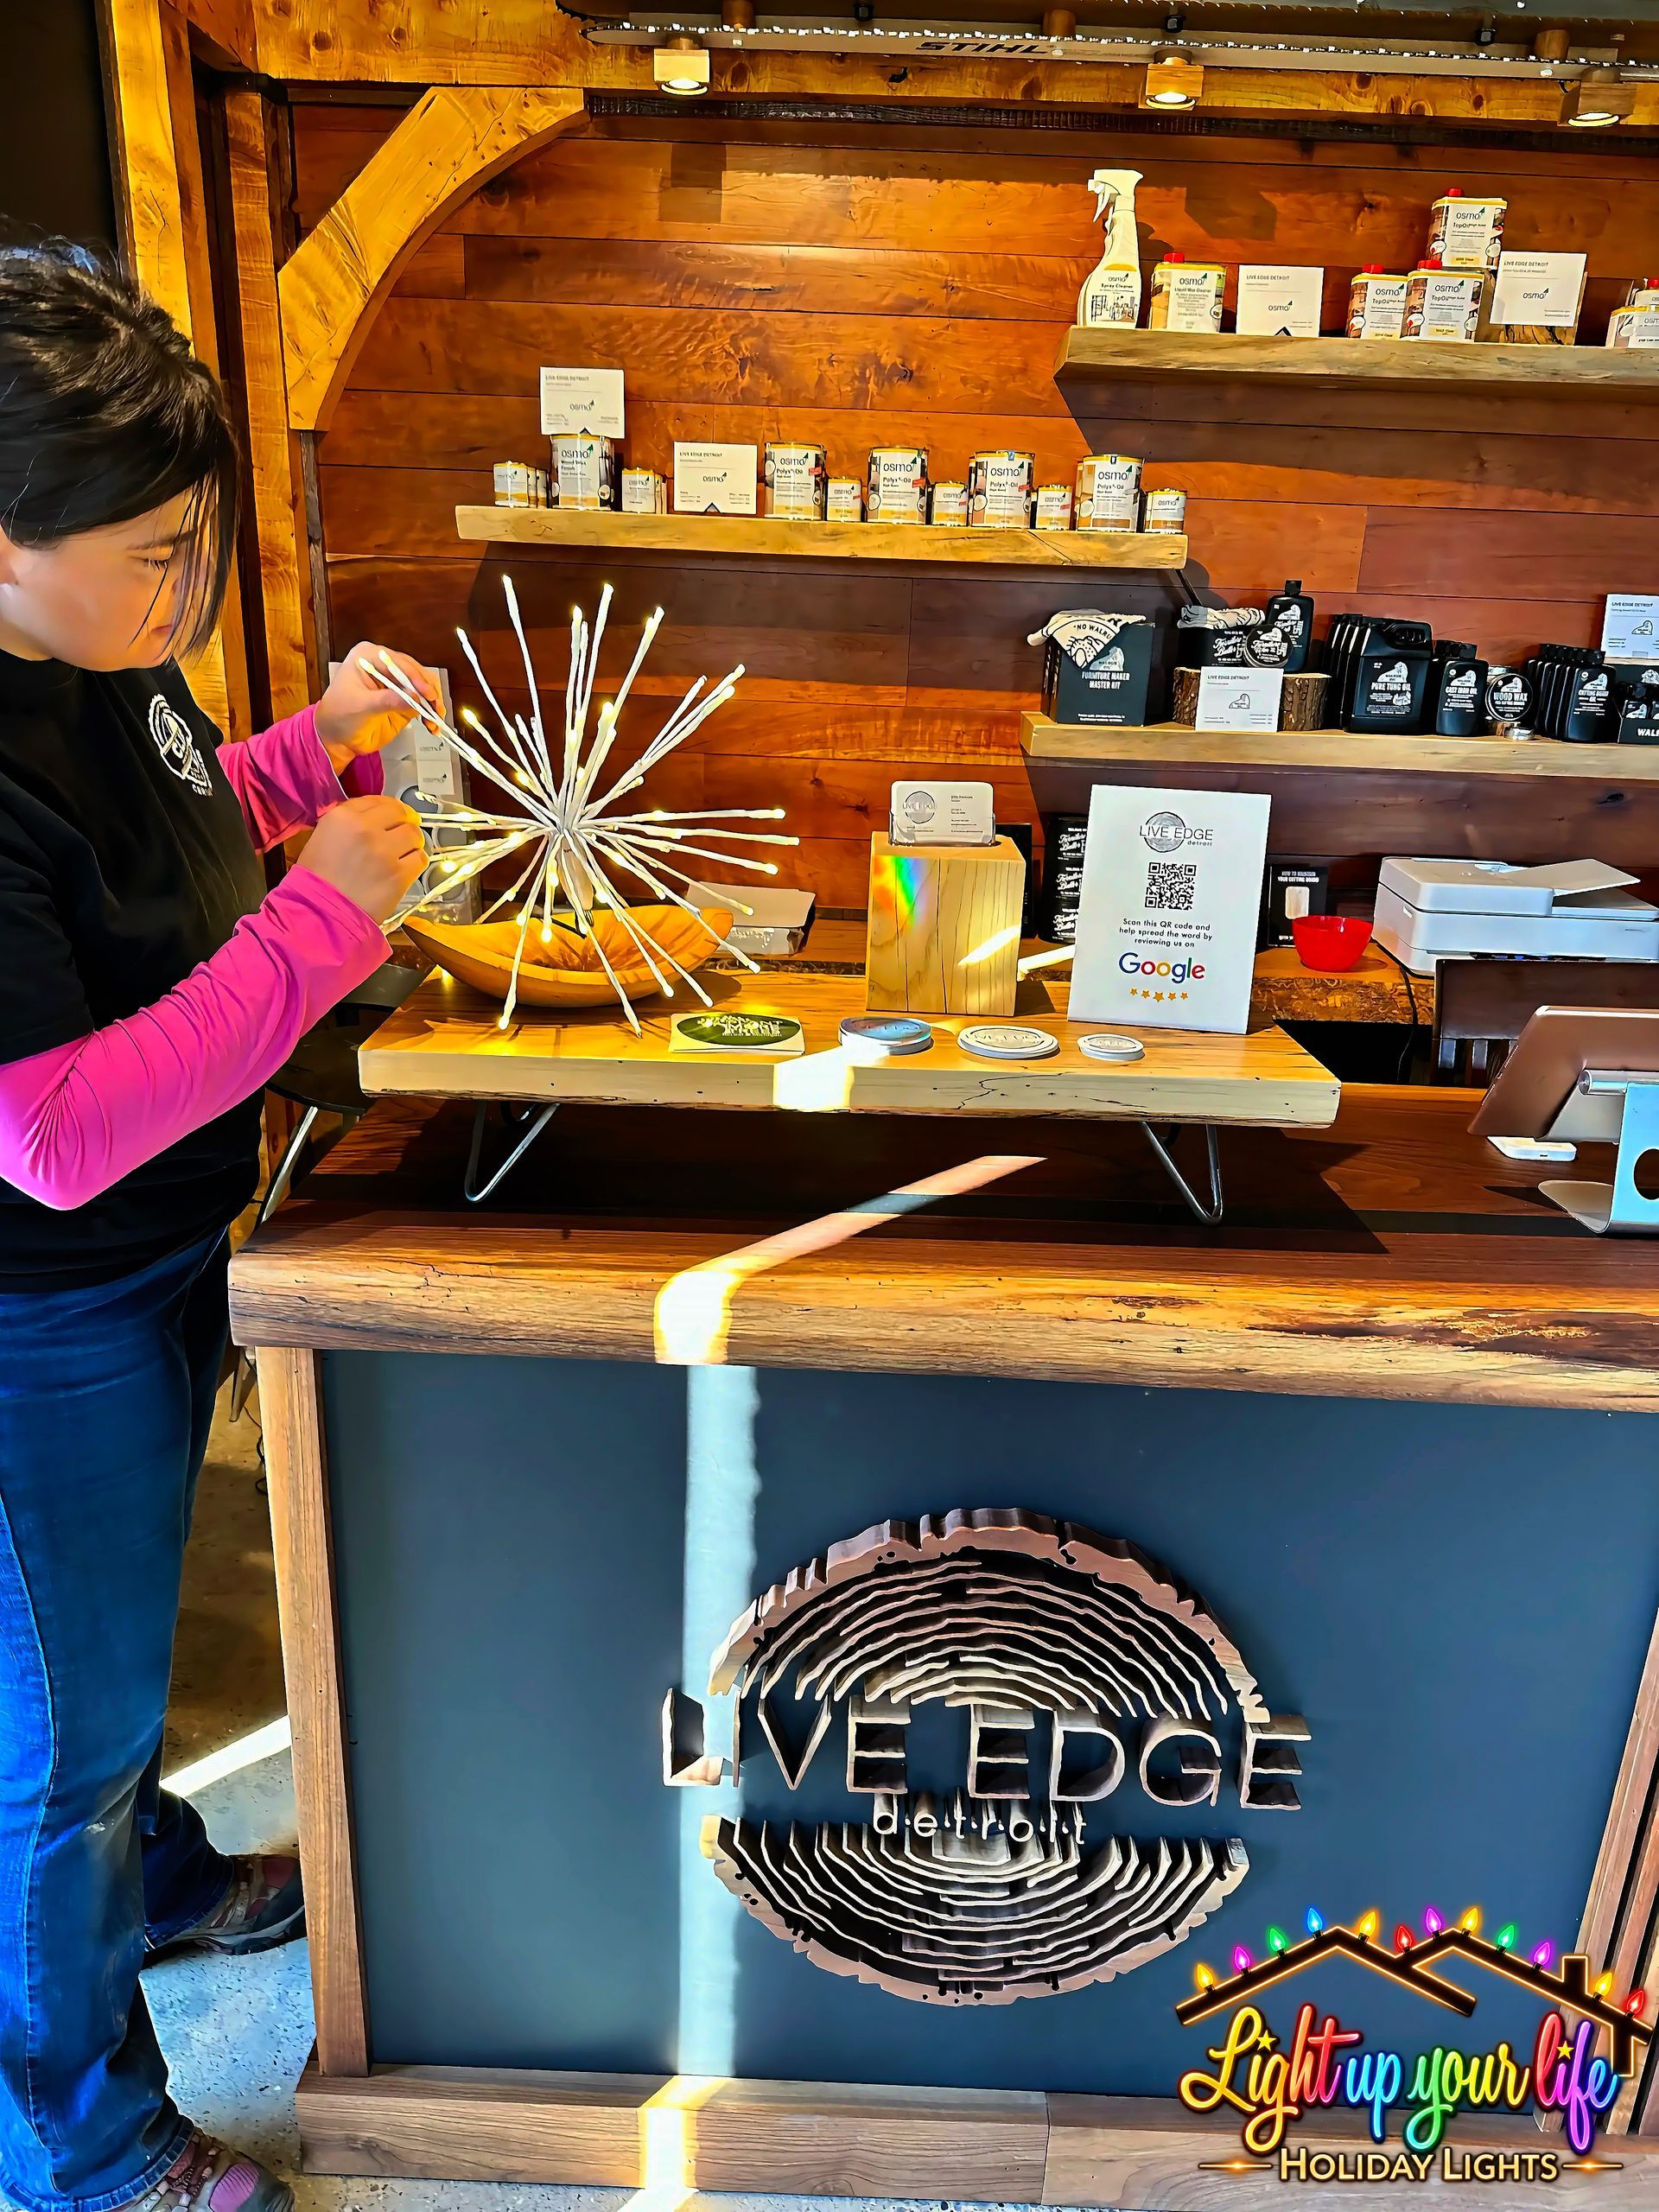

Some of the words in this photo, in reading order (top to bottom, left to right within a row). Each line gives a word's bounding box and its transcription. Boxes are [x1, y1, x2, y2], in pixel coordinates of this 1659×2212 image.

[915, 41, 1047, 54] STIHL
[1456, 212, 1480, 220] osmo
[1179, 277, 1203, 286] osmo
[1376, 288, 1401, 296] osmo
[1434, 284, 1459, 293] osmo
[561, 449, 588, 459] osmo
[779, 457, 805, 466] osmo
[883, 462, 912, 473] osmo
[990, 467, 1020, 477] osmo
[1097, 471, 1128, 480] osmo
[1370, 682, 1386, 690] PURE
[1387, 683, 1402, 691] TUNG
[1402, 683, 1411, 691] OIL
[1493, 691, 1513, 701] WOOD
[1513, 692, 1529, 702] WAX
[1139, 824, 1170, 838] LIVE
[1173, 827, 1214, 842] EDGE
[1119, 926, 1136, 935] help
[1203, 932, 1213, 941] by
[1135, 938, 1171, 947] reviewing
[1118, 951, 1206, 984] Google
[661, 1687, 912, 1795] LIVE
[967, 1702, 1313, 1809] EDGE
